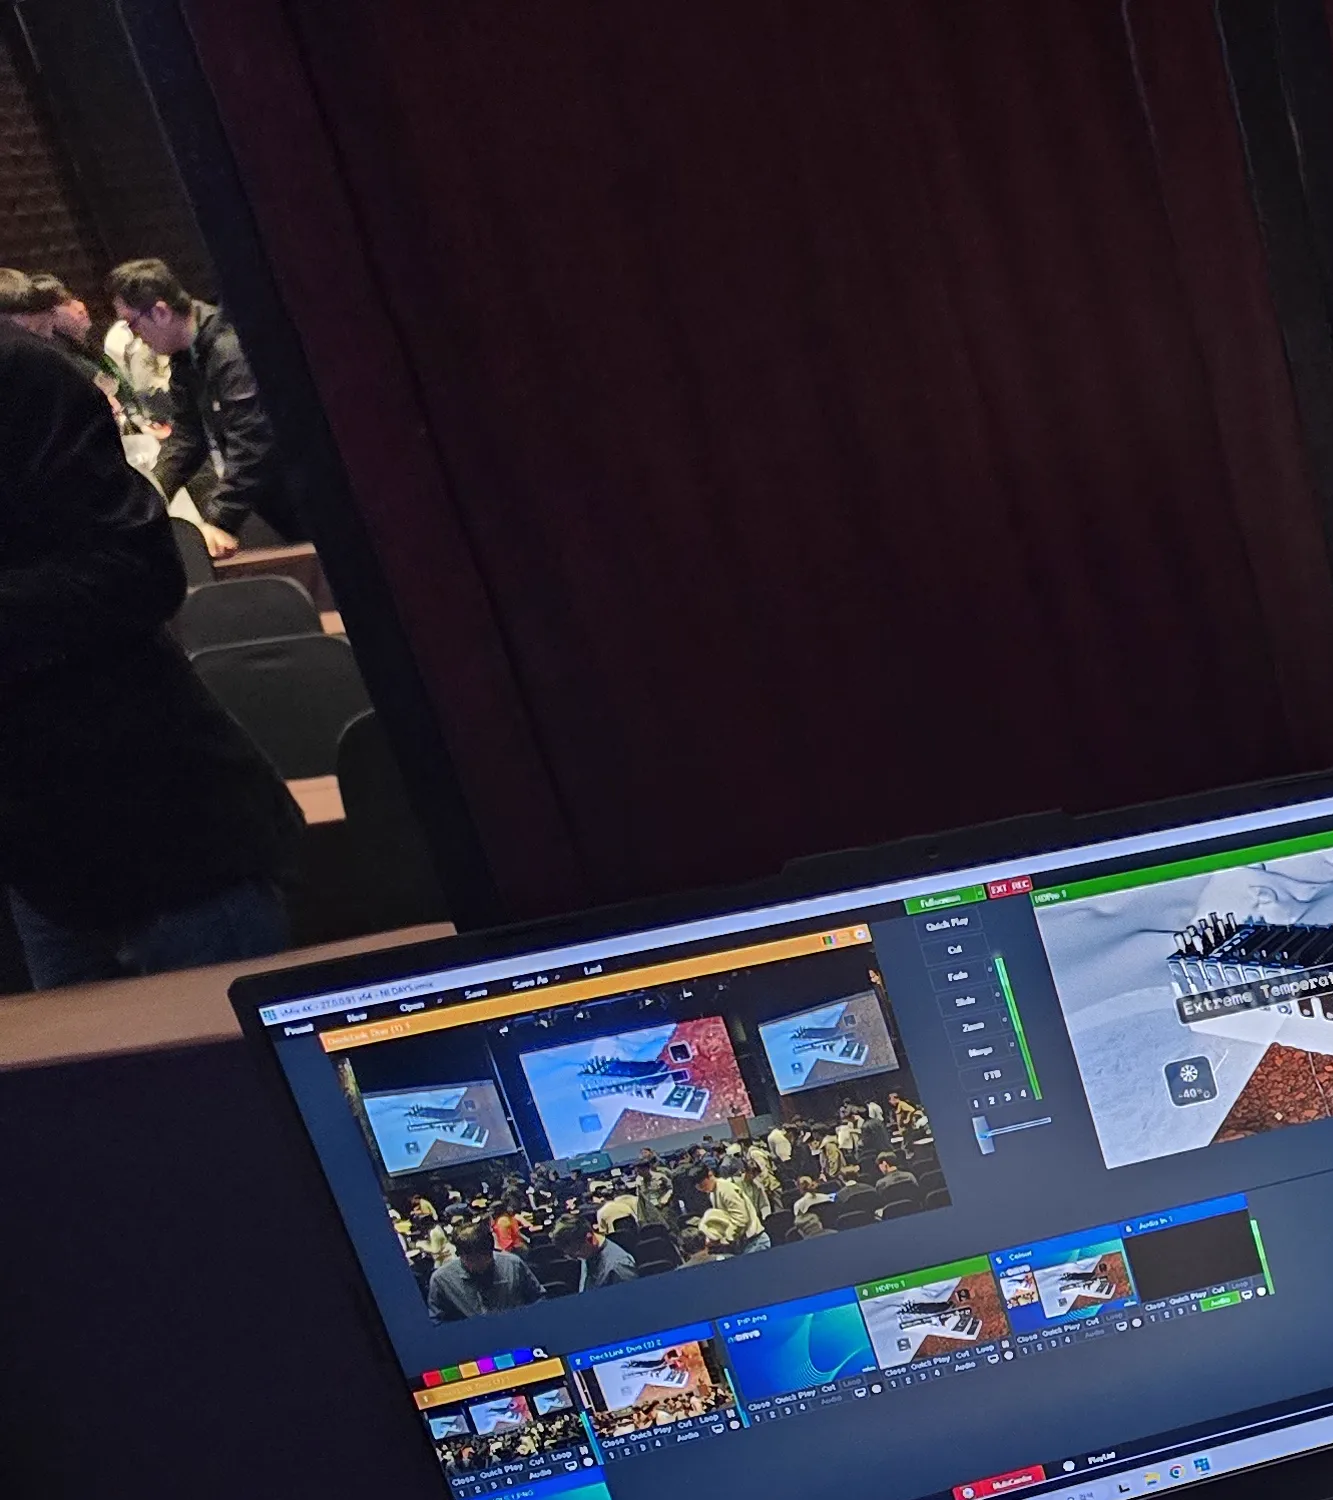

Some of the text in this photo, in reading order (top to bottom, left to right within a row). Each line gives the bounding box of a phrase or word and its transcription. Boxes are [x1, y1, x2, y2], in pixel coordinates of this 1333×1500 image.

[990, 879, 1029, 895] EXT REC
[926, 917, 968, 931] Quick Play
[947, 945, 962, 954] Cut
[1183, 992, 1250, 1016] Extreme
[956, 1349, 970, 1359] Cut
[976, 1343, 994, 1356] Loop
[955, 1360, 976, 1372] Audio
[748, 1383, 836, 1411] Close Play Cut
[602, 1437, 624, 1448] Close
[654, 1425, 671, 1435] Play
[677, 1420, 692, 1429] Cut
[700, 1414, 718, 1424] Loop
[677, 1431, 699, 1442] Audio
[504, 1463, 523, 1473] Play
[529, 1457, 544, 1466] Cut
[551, 1451, 572, 1461] Loop
[529, 1469, 551, 1480] Audio
